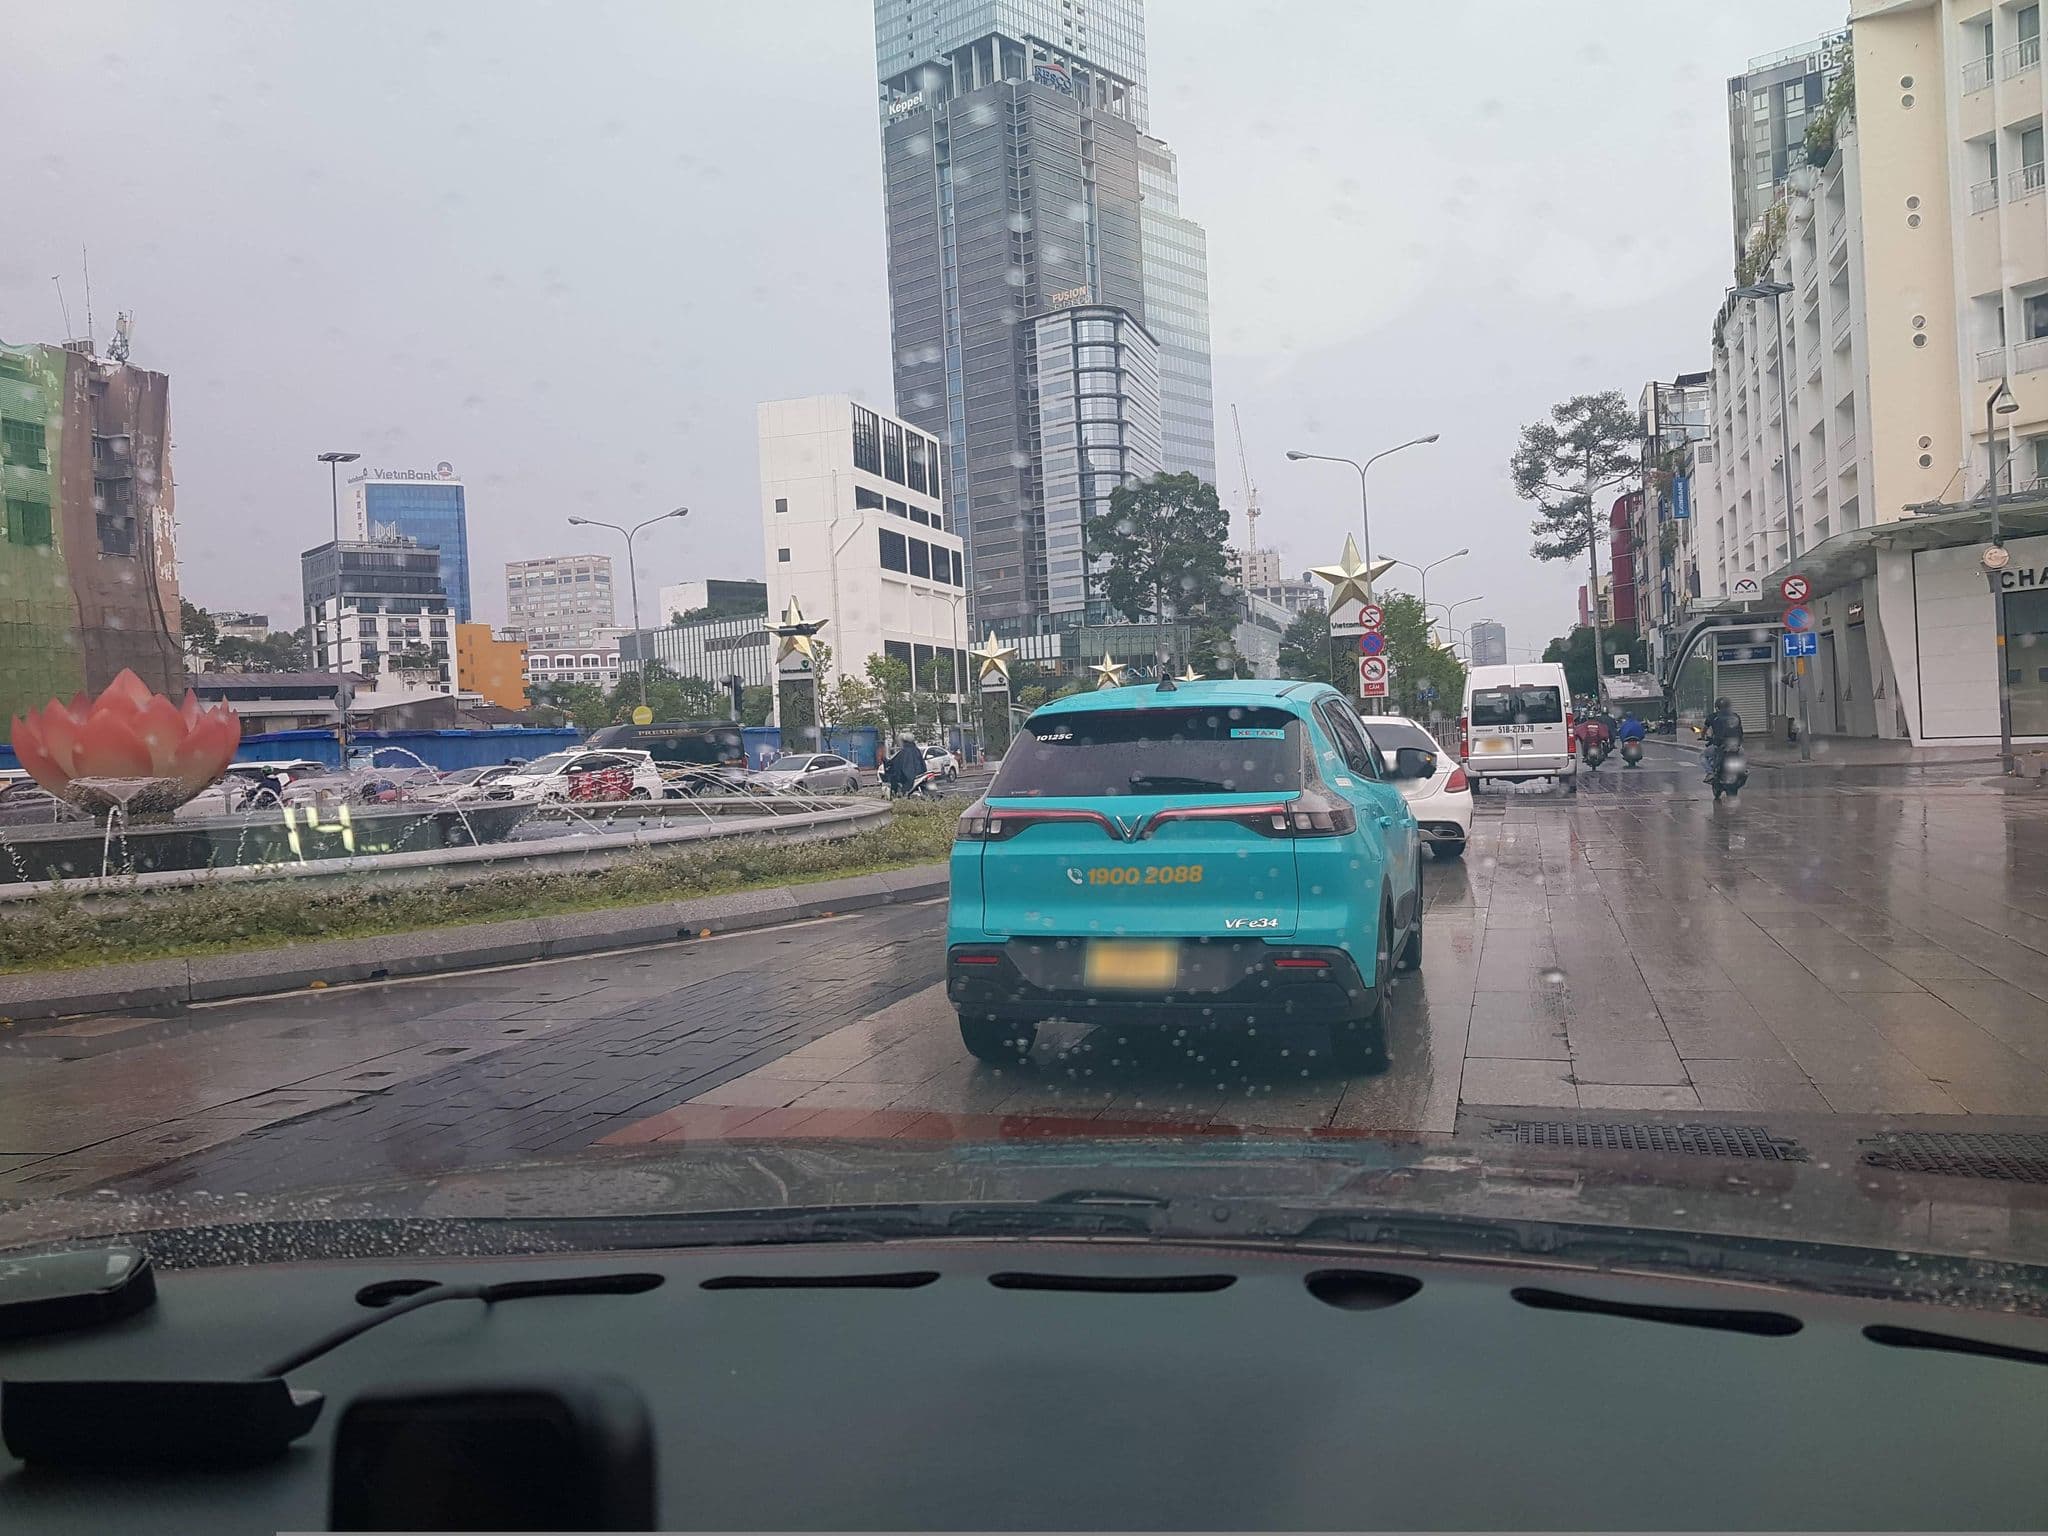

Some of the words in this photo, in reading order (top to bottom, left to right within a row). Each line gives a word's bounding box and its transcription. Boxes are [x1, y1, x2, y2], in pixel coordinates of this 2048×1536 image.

[889, 91, 923, 115] Keppel
[1052, 286, 1087, 303] FUSION
[374, 469, 438, 480] VietinBank
[1036, 733, 1073, 742] 10125C
[1088, 867, 1141, 885] 1900
[1144, 865, 1203, 884] 2088
